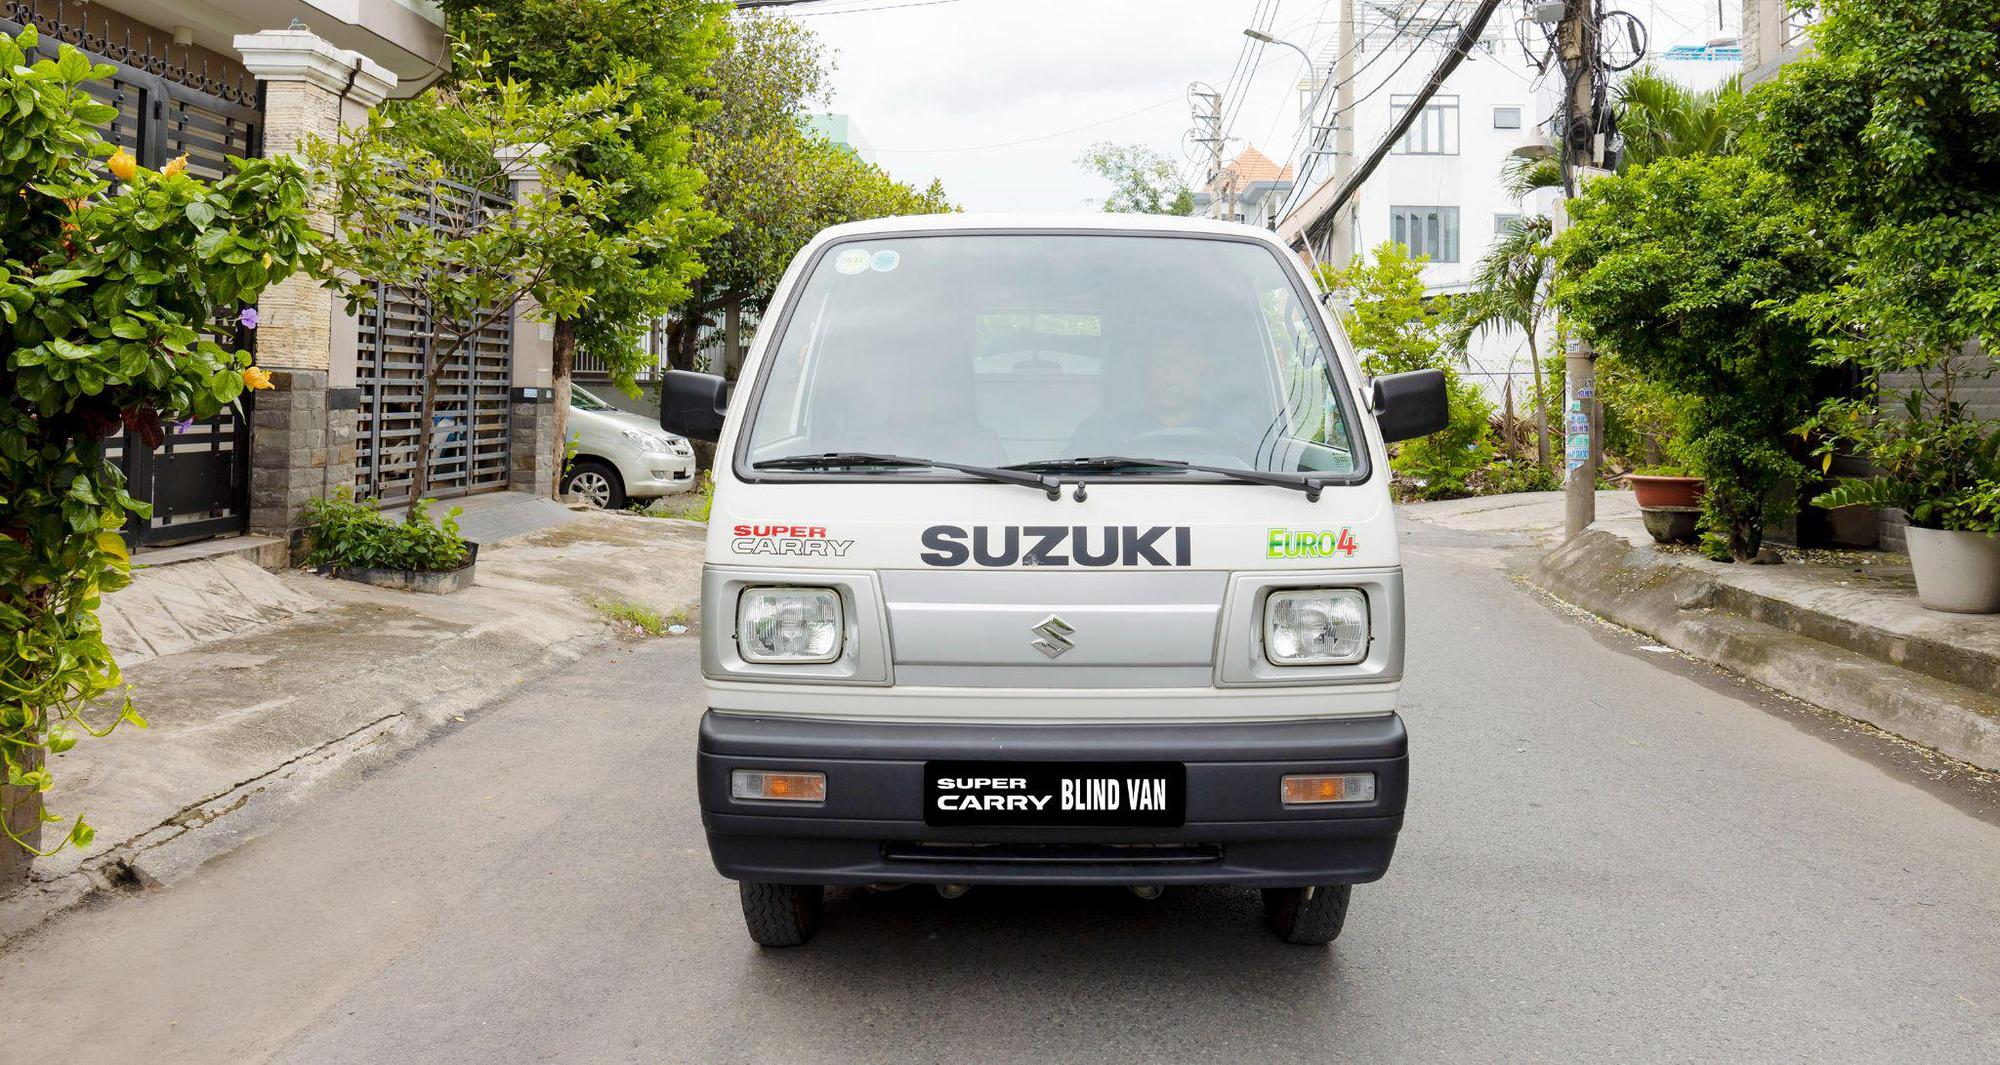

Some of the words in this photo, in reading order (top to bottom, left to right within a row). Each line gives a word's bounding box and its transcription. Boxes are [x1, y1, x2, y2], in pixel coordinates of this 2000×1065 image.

[733, 524, 827, 538] SUPER
[731, 538, 855, 557] CARRY
[920, 525, 1192, 566] SUZUKI
[937, 778, 1027, 790] SUPER
[937, 795, 1053, 811] CARRY
[1061, 778, 1120, 811] BLIND
[1126, 778, 1167, 811] VAN
